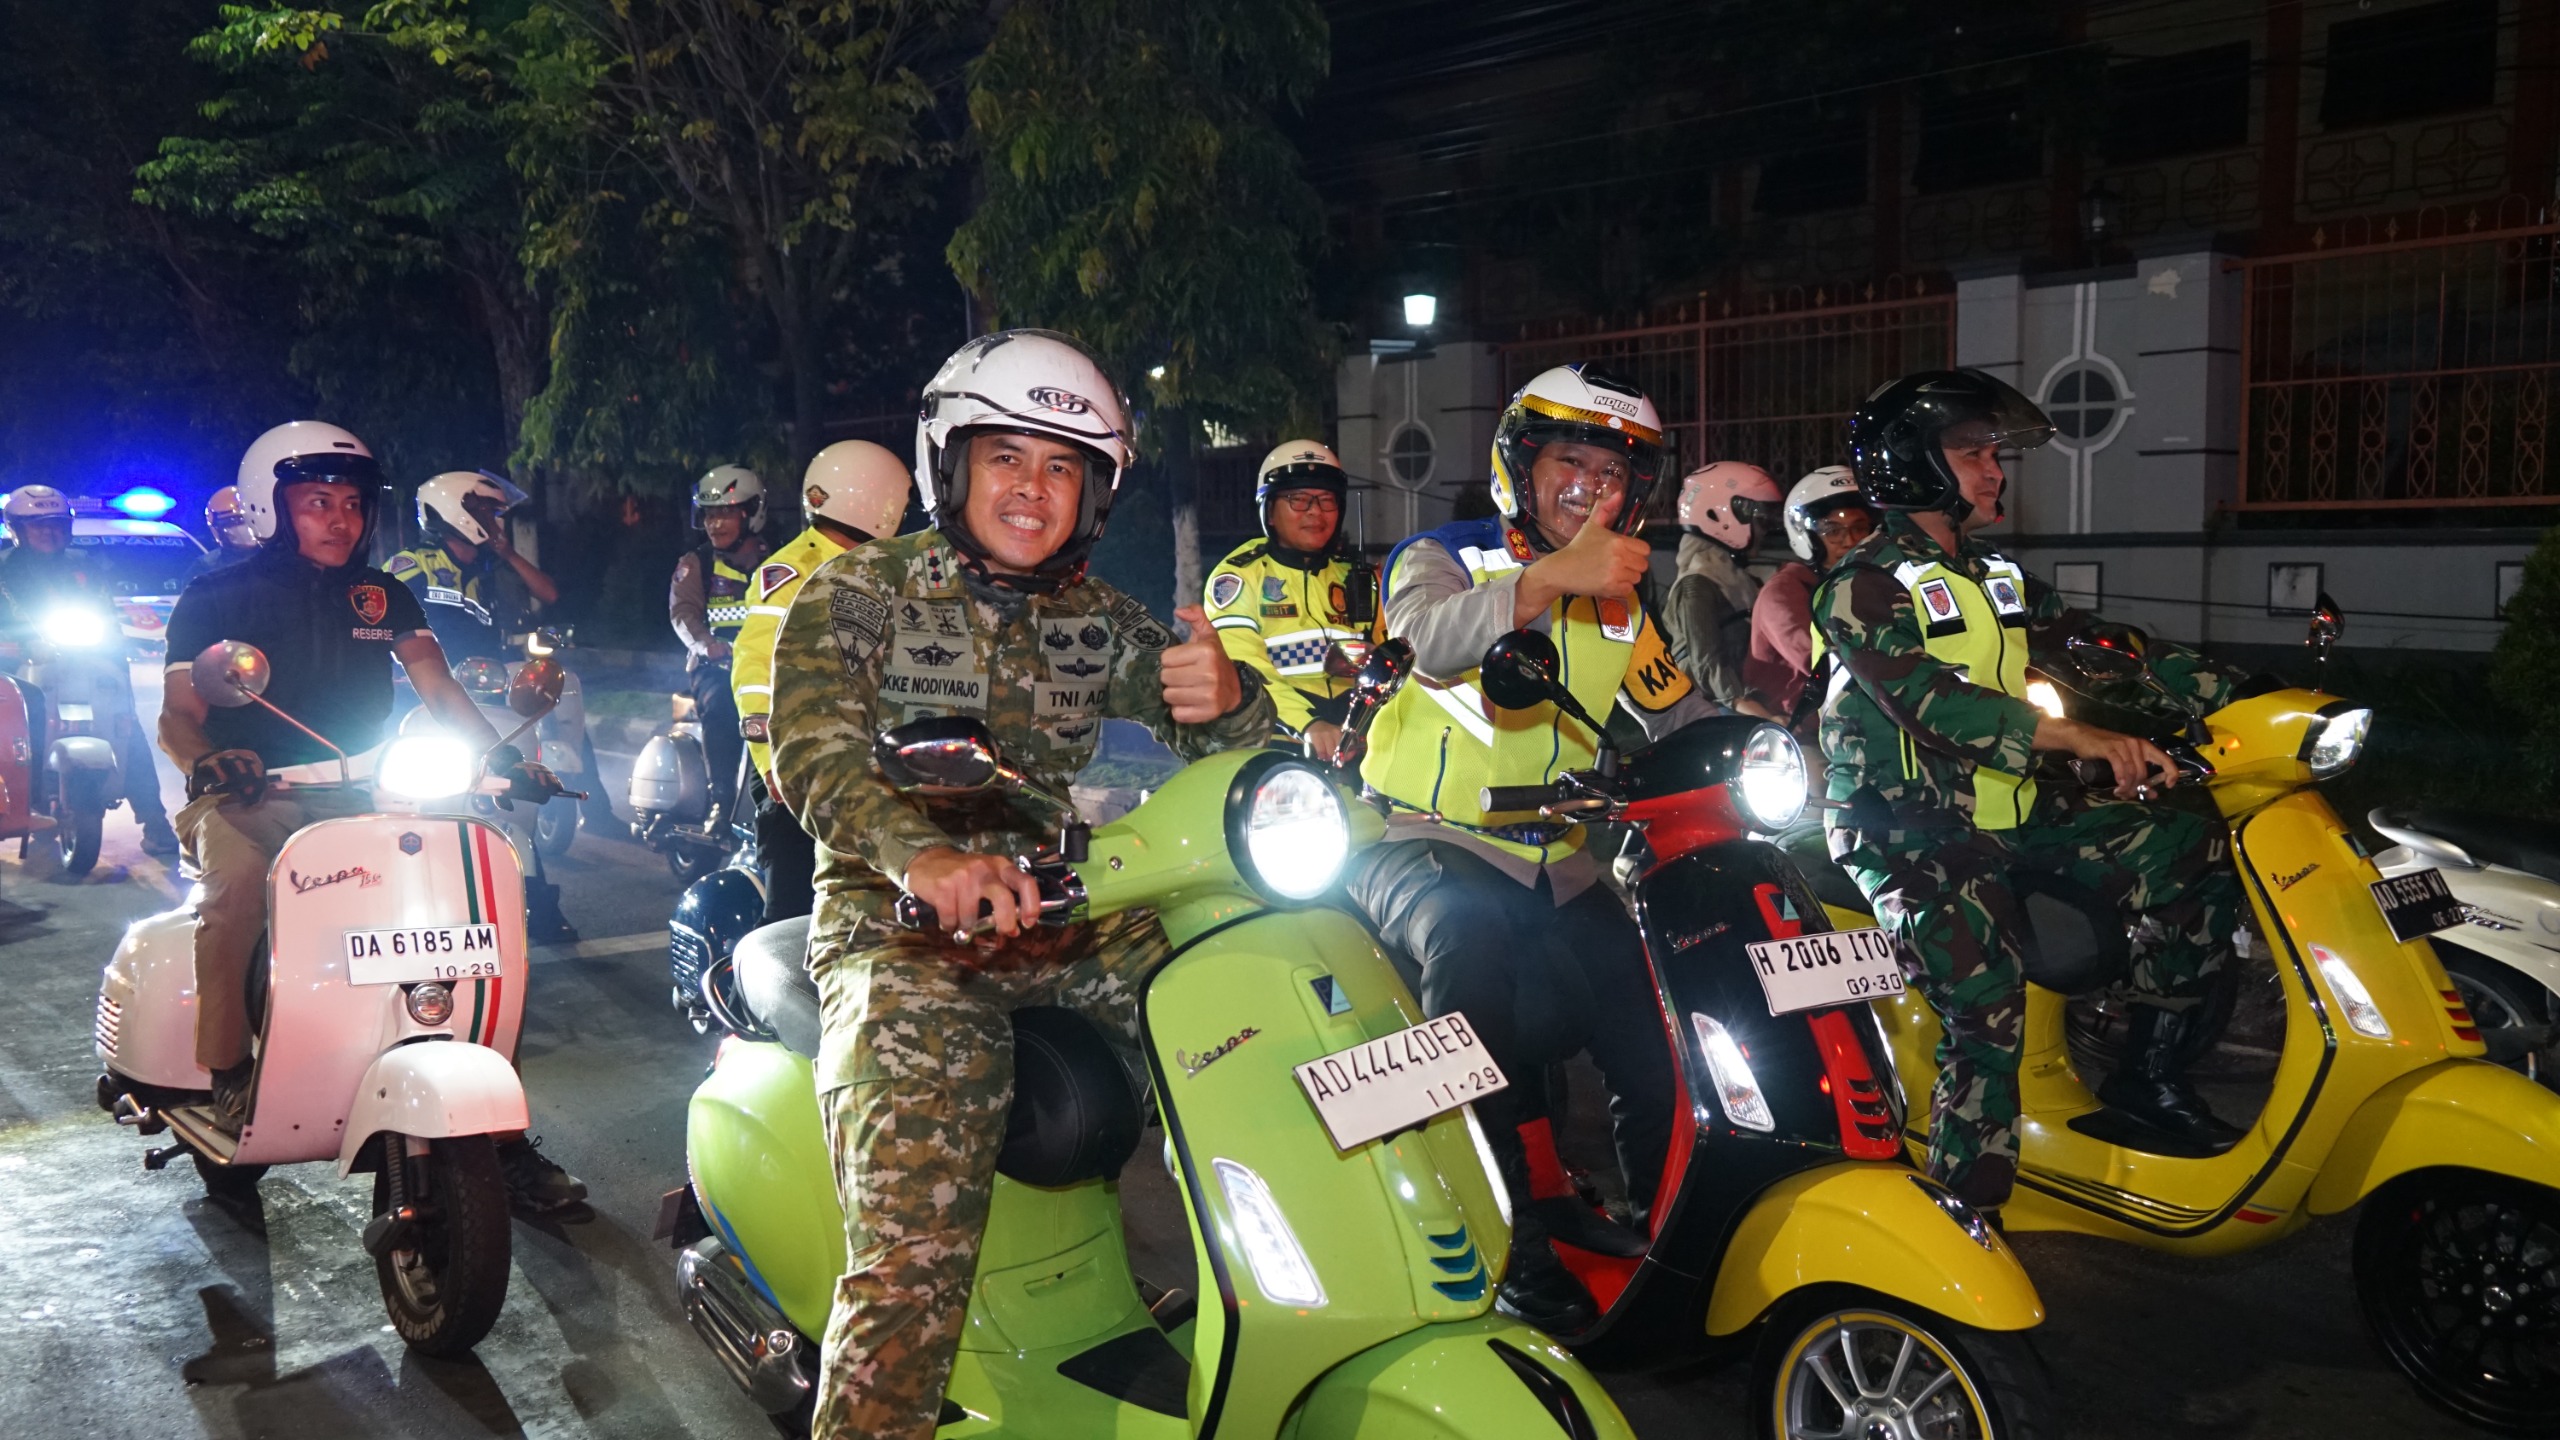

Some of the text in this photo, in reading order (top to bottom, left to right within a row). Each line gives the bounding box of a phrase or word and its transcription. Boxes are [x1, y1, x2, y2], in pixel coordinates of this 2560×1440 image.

[1594, 396, 1638, 416] NOLAN
[70, 535, 185, 547] OPAM
[836, 599, 882, 623] RAIDER
[840, 590, 884, 614] CAKRA
[352, 627, 394, 641] RESERSE
[911, 677, 980, 699] NODIYARJO
[1049, 690, 1106, 707] TNI AD
[290, 867, 366, 894] Vespa
[2271, 863, 2321, 892] Vespa
[2374, 883, 2399, 911] AD
[2393, 875, 2431, 905] 5555
[351, 927, 493, 957] DA 6185 AM
[1753, 946, 1776, 976] H
[1780, 936, 1842, 972] 2006
[1176, 1026, 1262, 1080] Vespa
